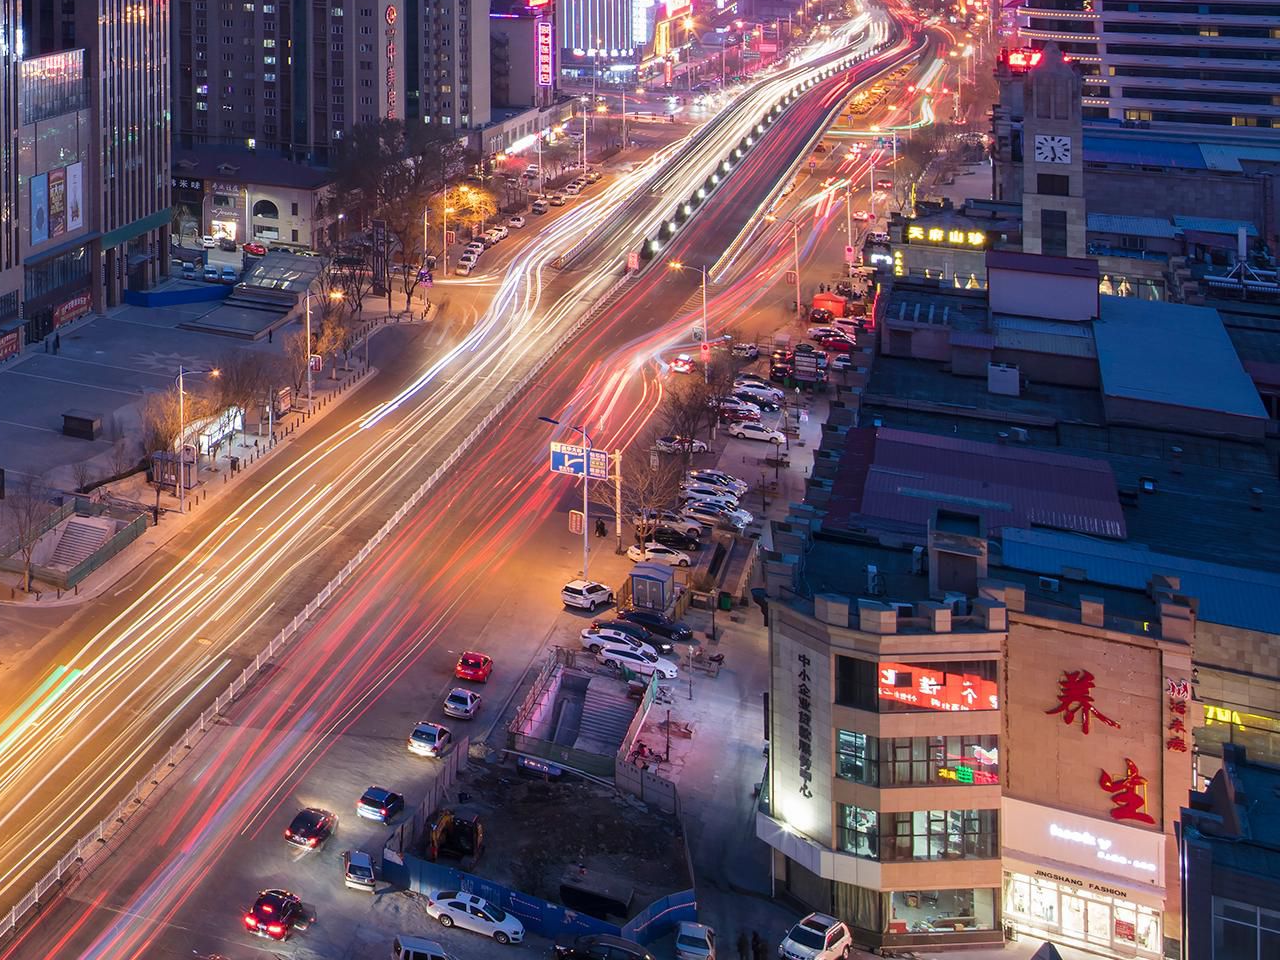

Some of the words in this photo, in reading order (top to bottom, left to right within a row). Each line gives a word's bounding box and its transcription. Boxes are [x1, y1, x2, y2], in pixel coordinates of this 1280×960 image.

[907, 225, 986, 245] 天府山珍
[1044, 668, 1157, 825] 养生
[1034, 869, 1083, 888] JINGSHANG
[1088, 883, 1128, 899] FASHION
